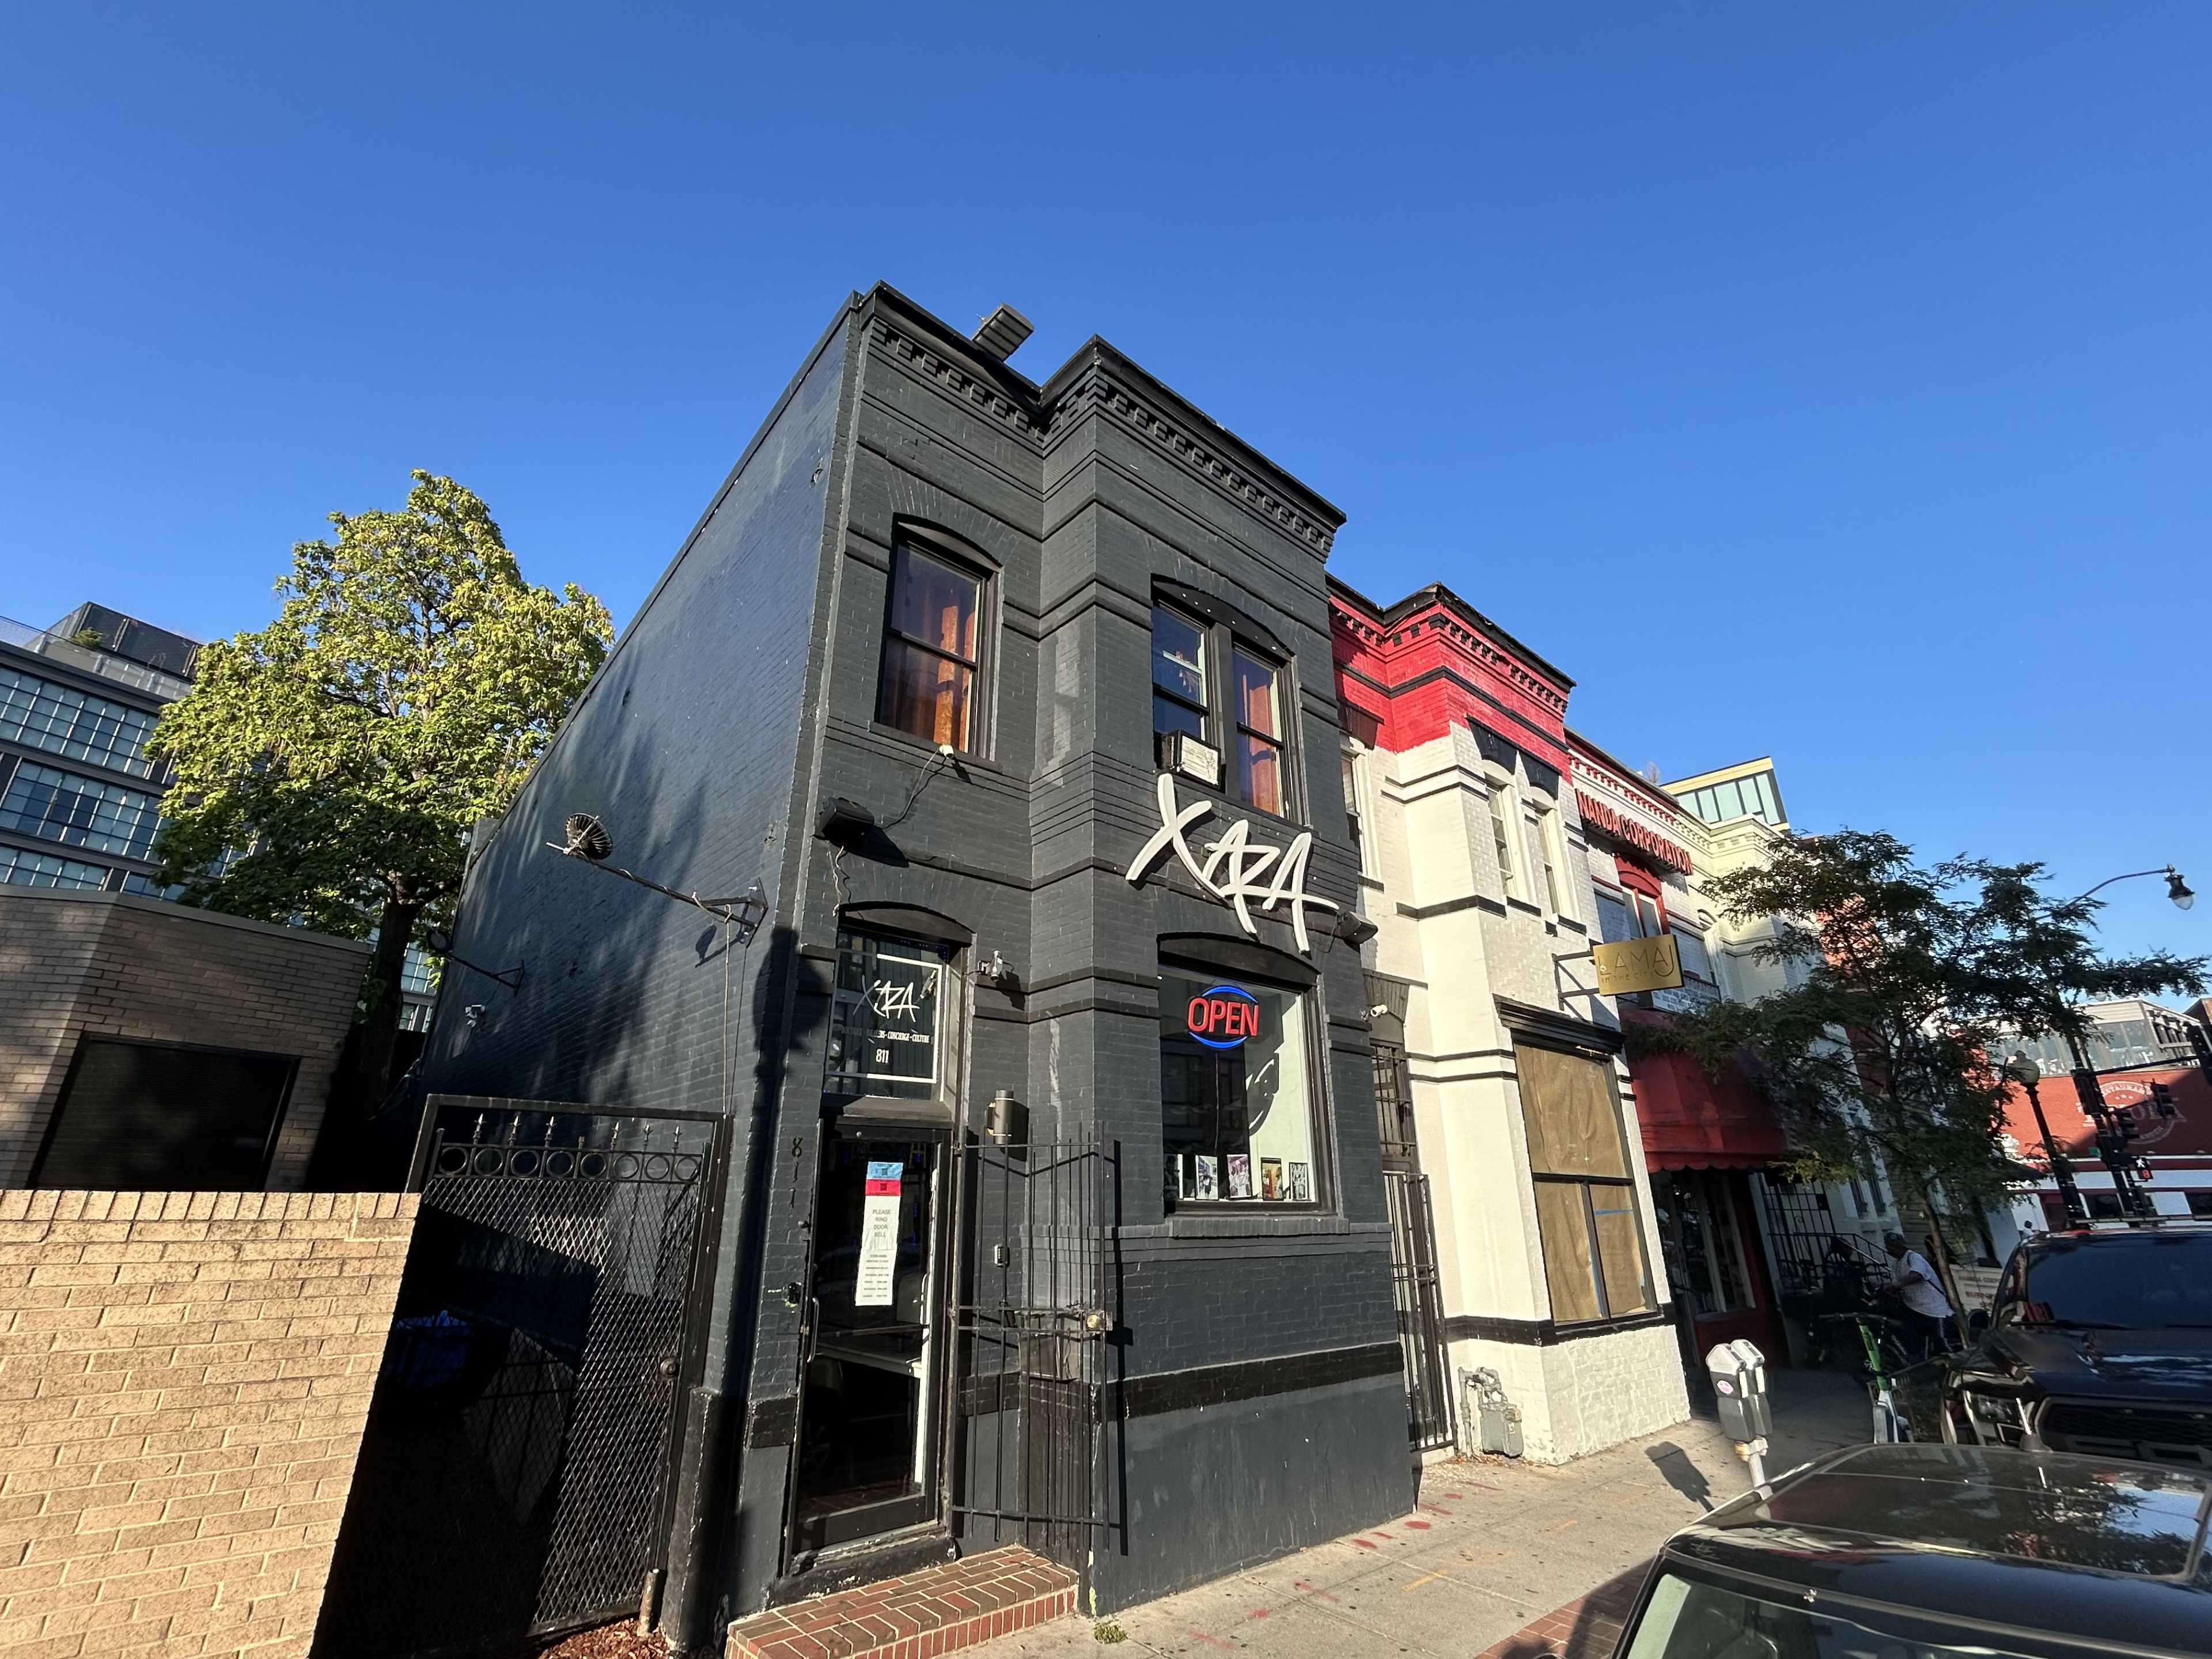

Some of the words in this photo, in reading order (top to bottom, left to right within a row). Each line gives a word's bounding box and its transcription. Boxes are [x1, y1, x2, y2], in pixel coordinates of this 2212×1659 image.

[1575, 788, 1620, 836] NANDA
[1619, 814, 1694, 876] CORPORATION
[1597, 944, 1675, 978] LAMAJ
[1187, 997, 1259, 1036] OPEN
[876, 1048, 889, 1063] 811
